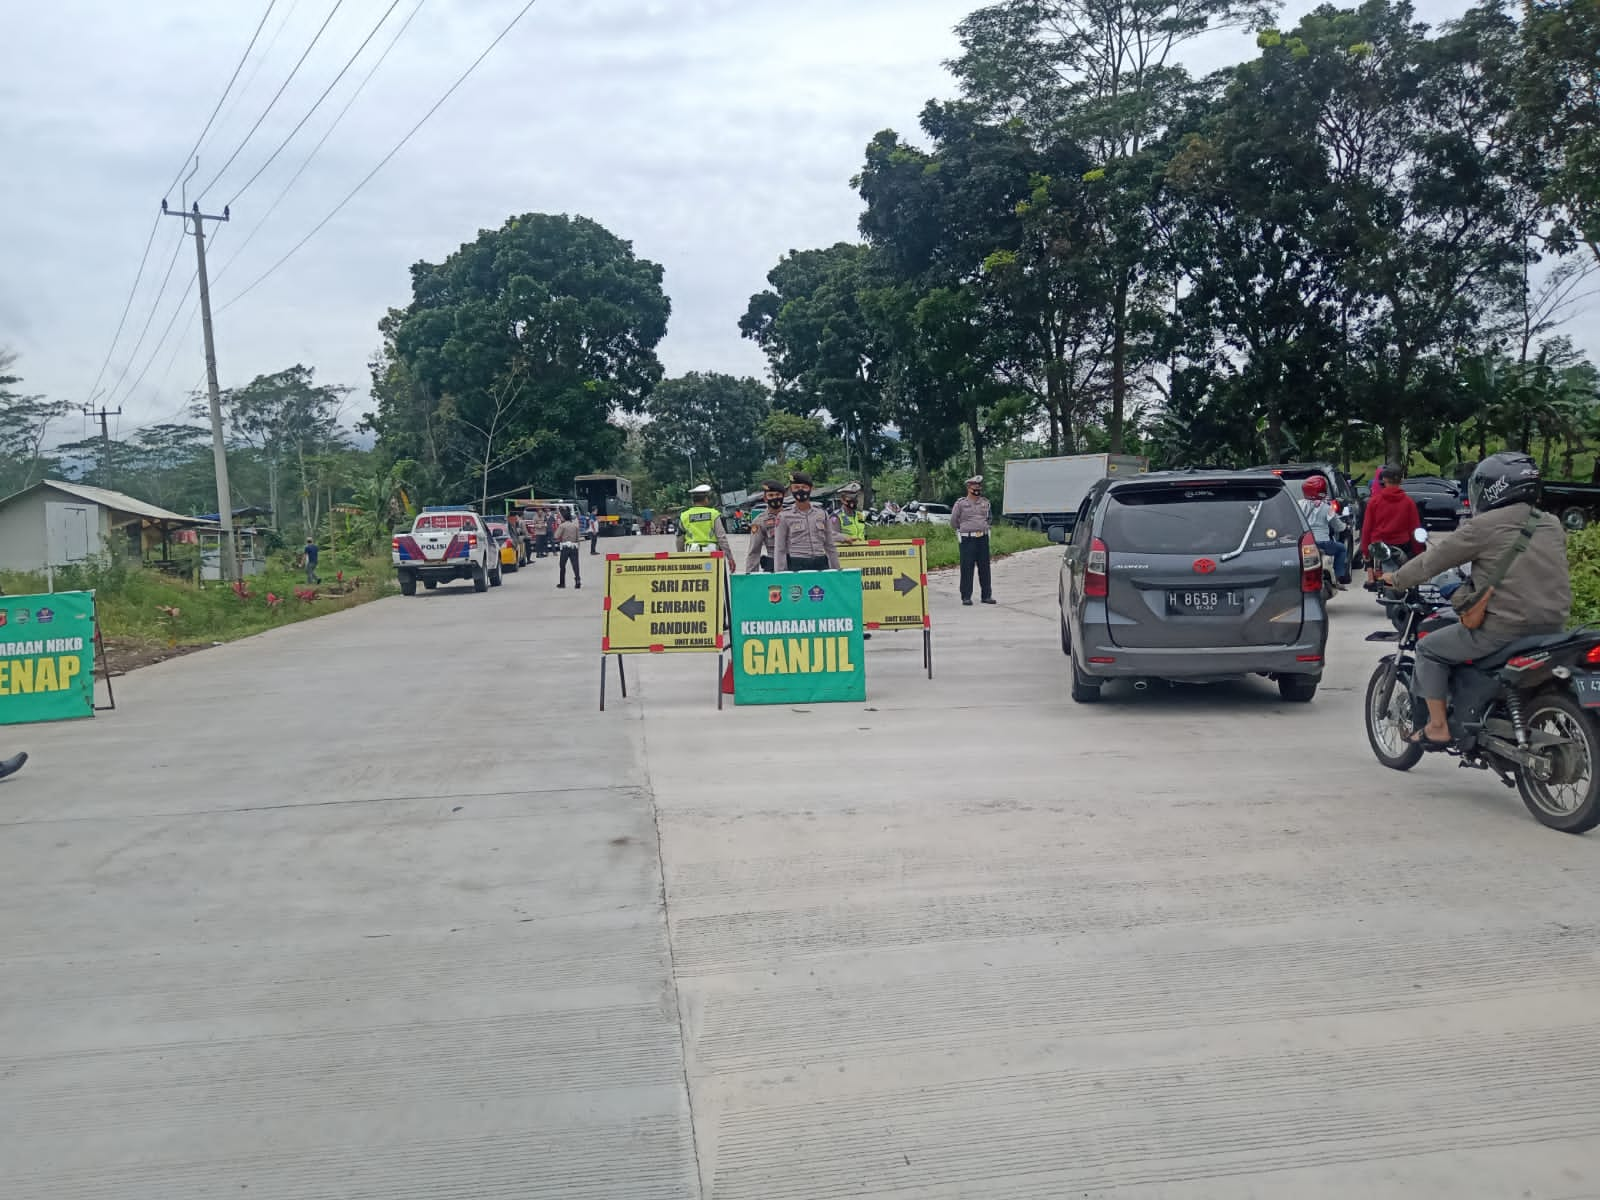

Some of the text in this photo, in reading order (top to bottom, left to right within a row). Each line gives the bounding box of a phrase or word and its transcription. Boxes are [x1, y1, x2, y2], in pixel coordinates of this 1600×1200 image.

[679, 563, 702, 571] SUBANG
[651, 579, 709, 592] SARI ATER
[1169, 592, 1240, 606] H 8658 TL
[651, 600, 706, 614] LEMBANG
[650, 621, 707, 635] BANDUNG
[741, 618, 854, 635] KENDARAAN NRKB
[46, 637, 83, 652] NRKB
[674, 637, 714, 646] UNIT KAMSEL
[743, 636, 855, 676] GANJIL
